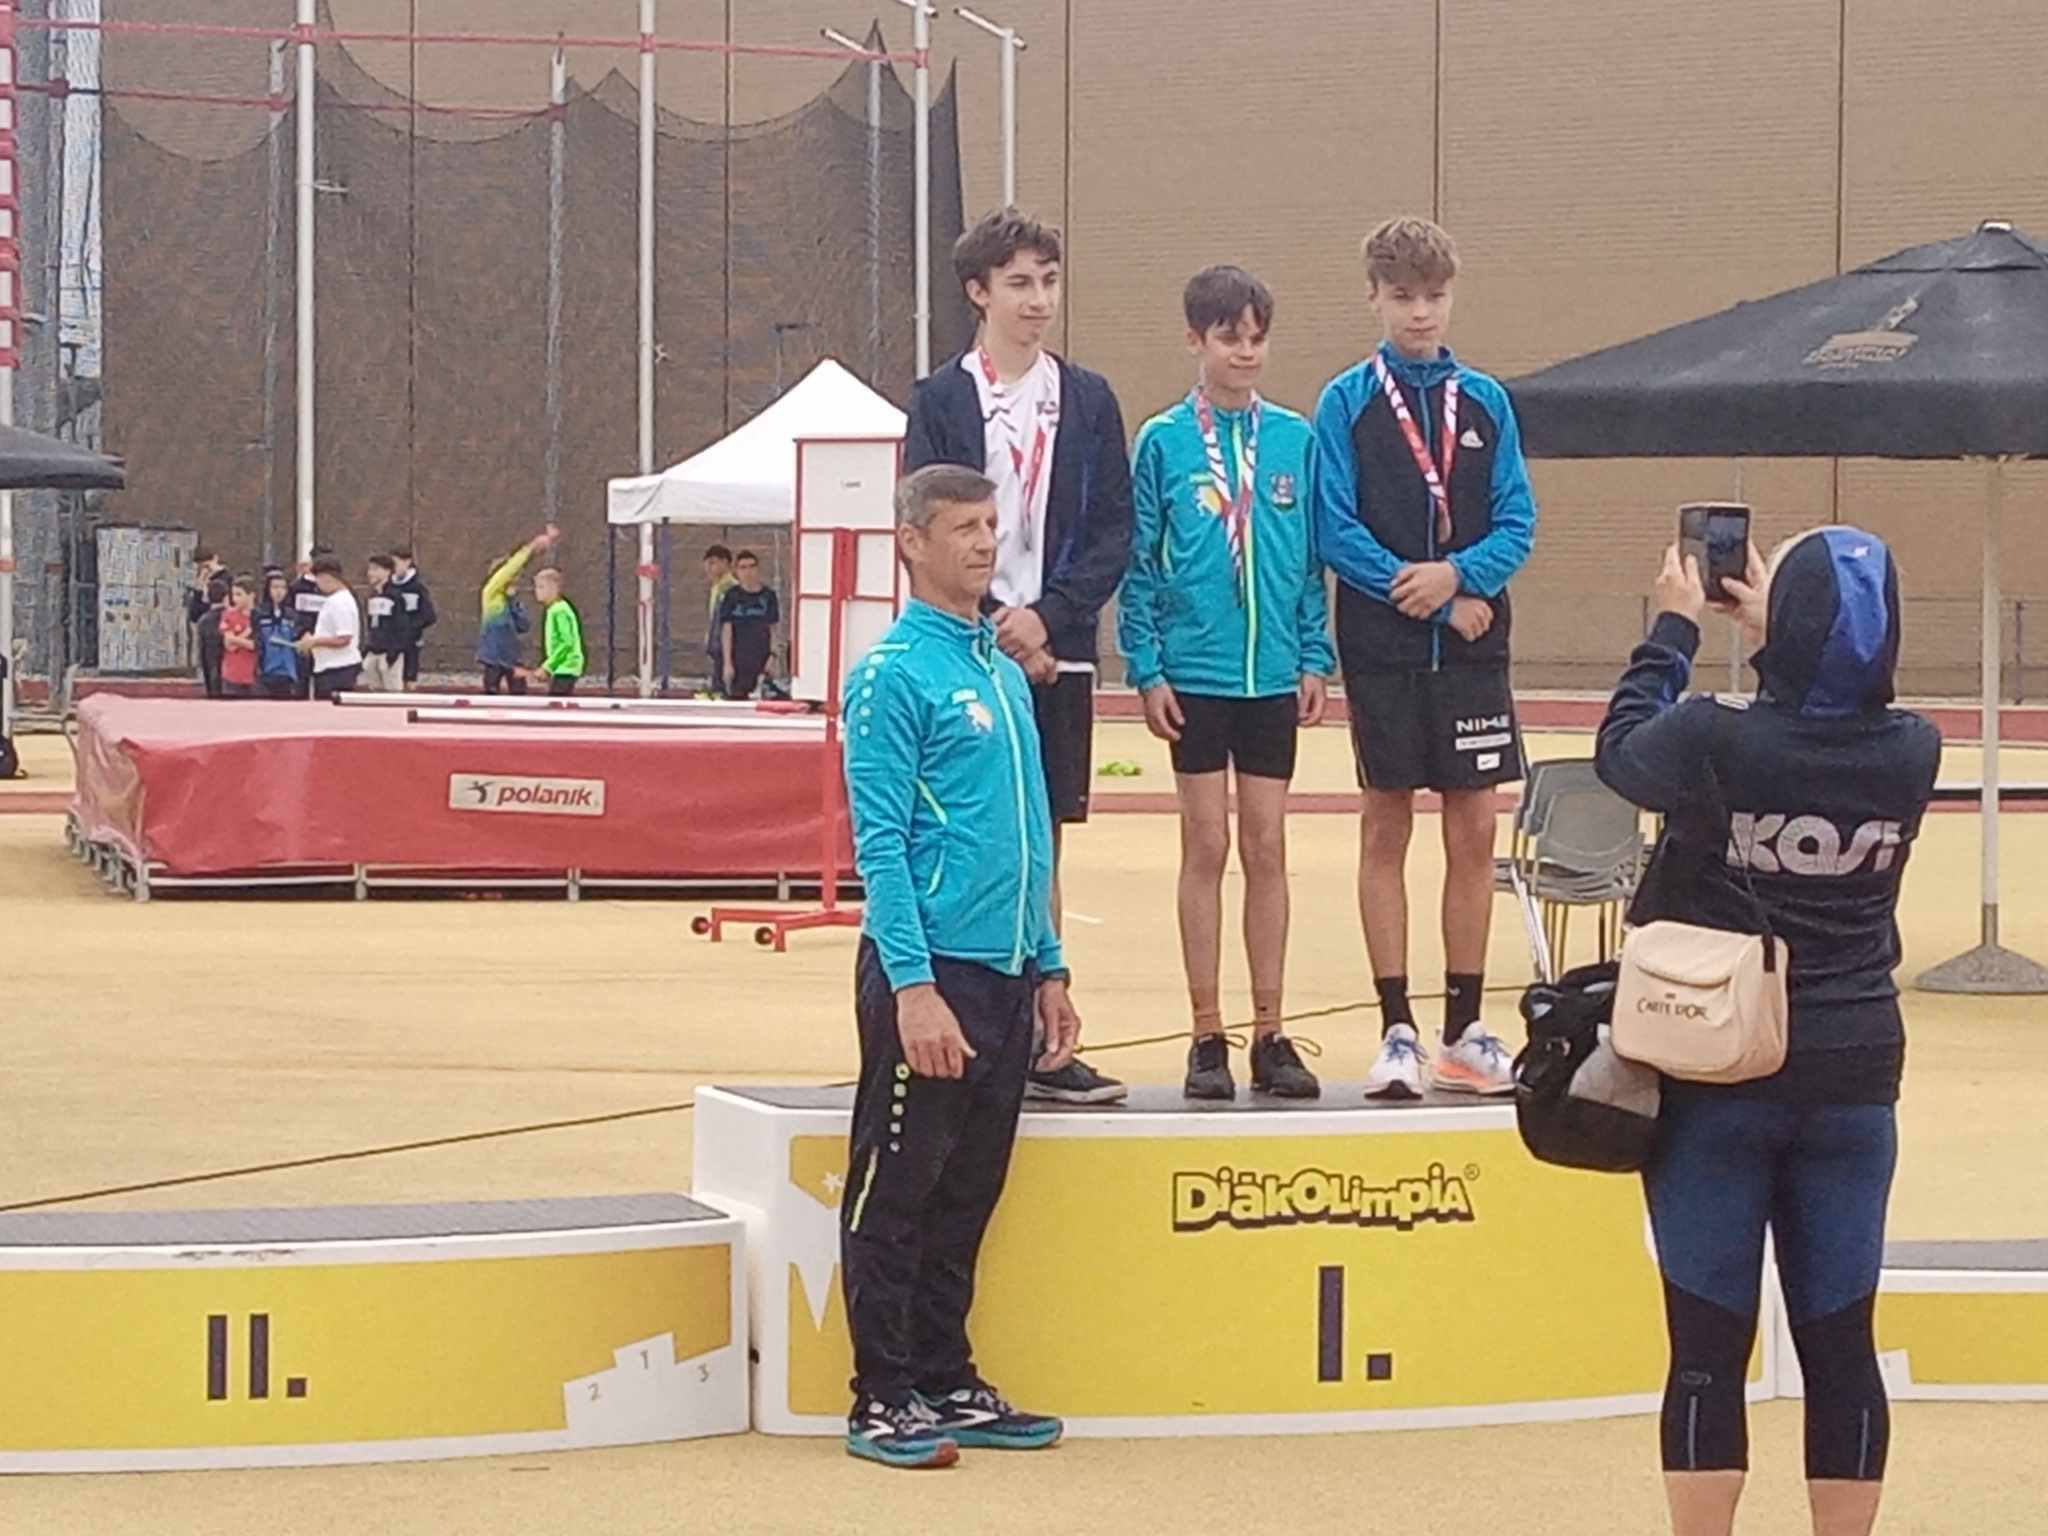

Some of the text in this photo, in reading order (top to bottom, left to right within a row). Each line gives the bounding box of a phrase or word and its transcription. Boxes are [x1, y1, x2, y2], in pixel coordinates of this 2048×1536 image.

[496, 783, 593, 806] polanik
[1317, 1264, 1393, 1384] I.
[206, 1312, 308, 1401] II.
[639, 1349, 650, 1371] 1
[697, 1362, 710, 1384] 3
[587, 1382, 602, 1402] 2
